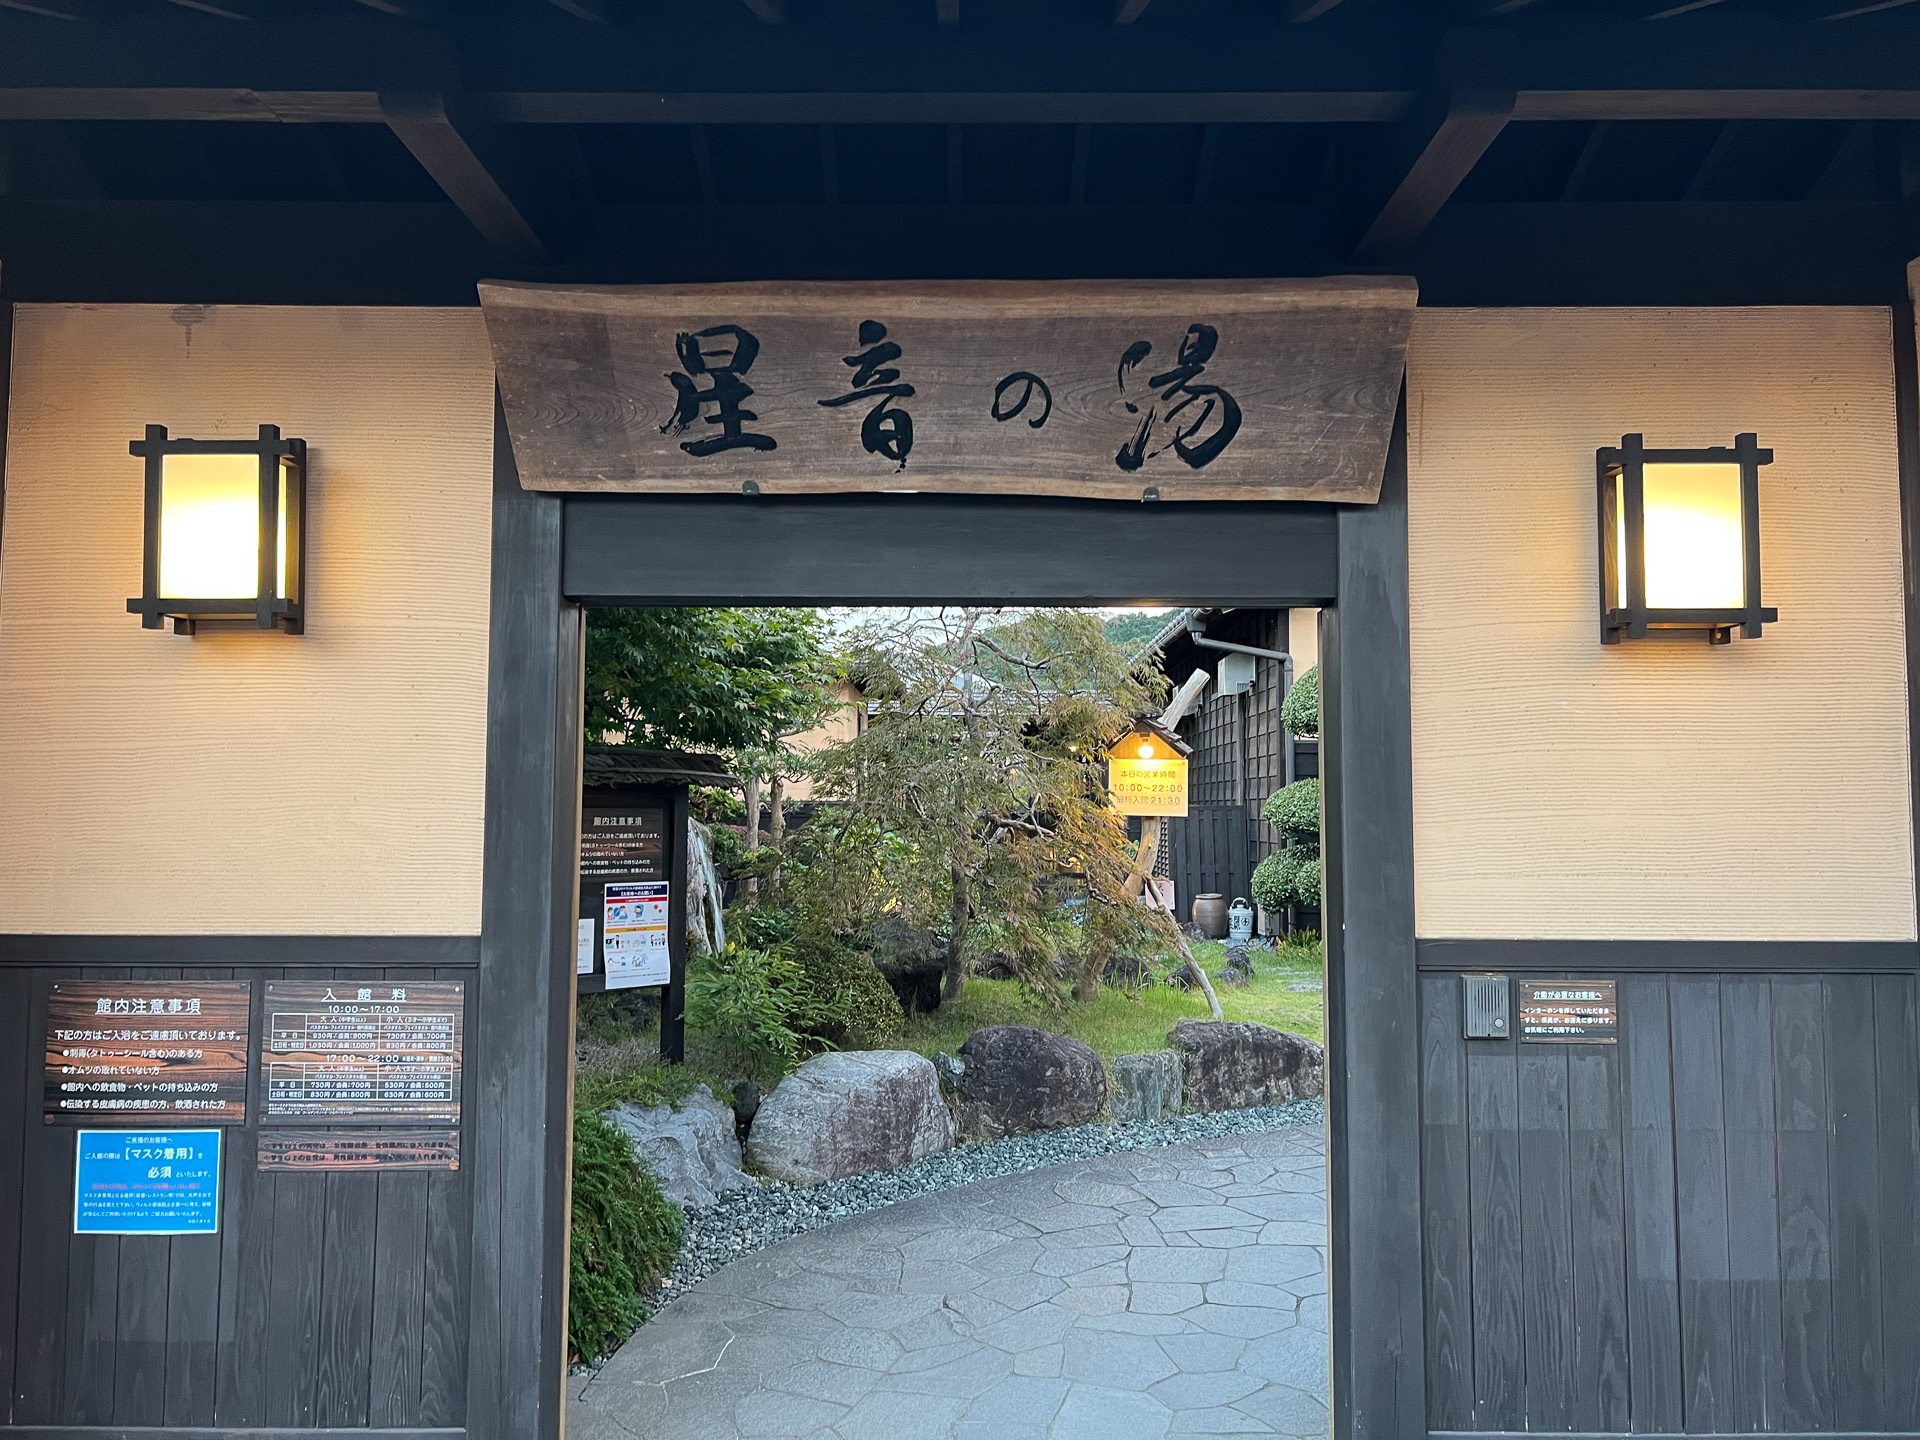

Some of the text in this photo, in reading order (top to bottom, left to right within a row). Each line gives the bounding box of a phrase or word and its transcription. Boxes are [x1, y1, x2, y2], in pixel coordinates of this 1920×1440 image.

[659, 319, 1241, 472] 星音の湯
[1120, 770, 1176, 778] 本日の営業時間
[96, 998, 201, 1014] 館内注意事項
[147, 1166, 172, 1178] 必須
